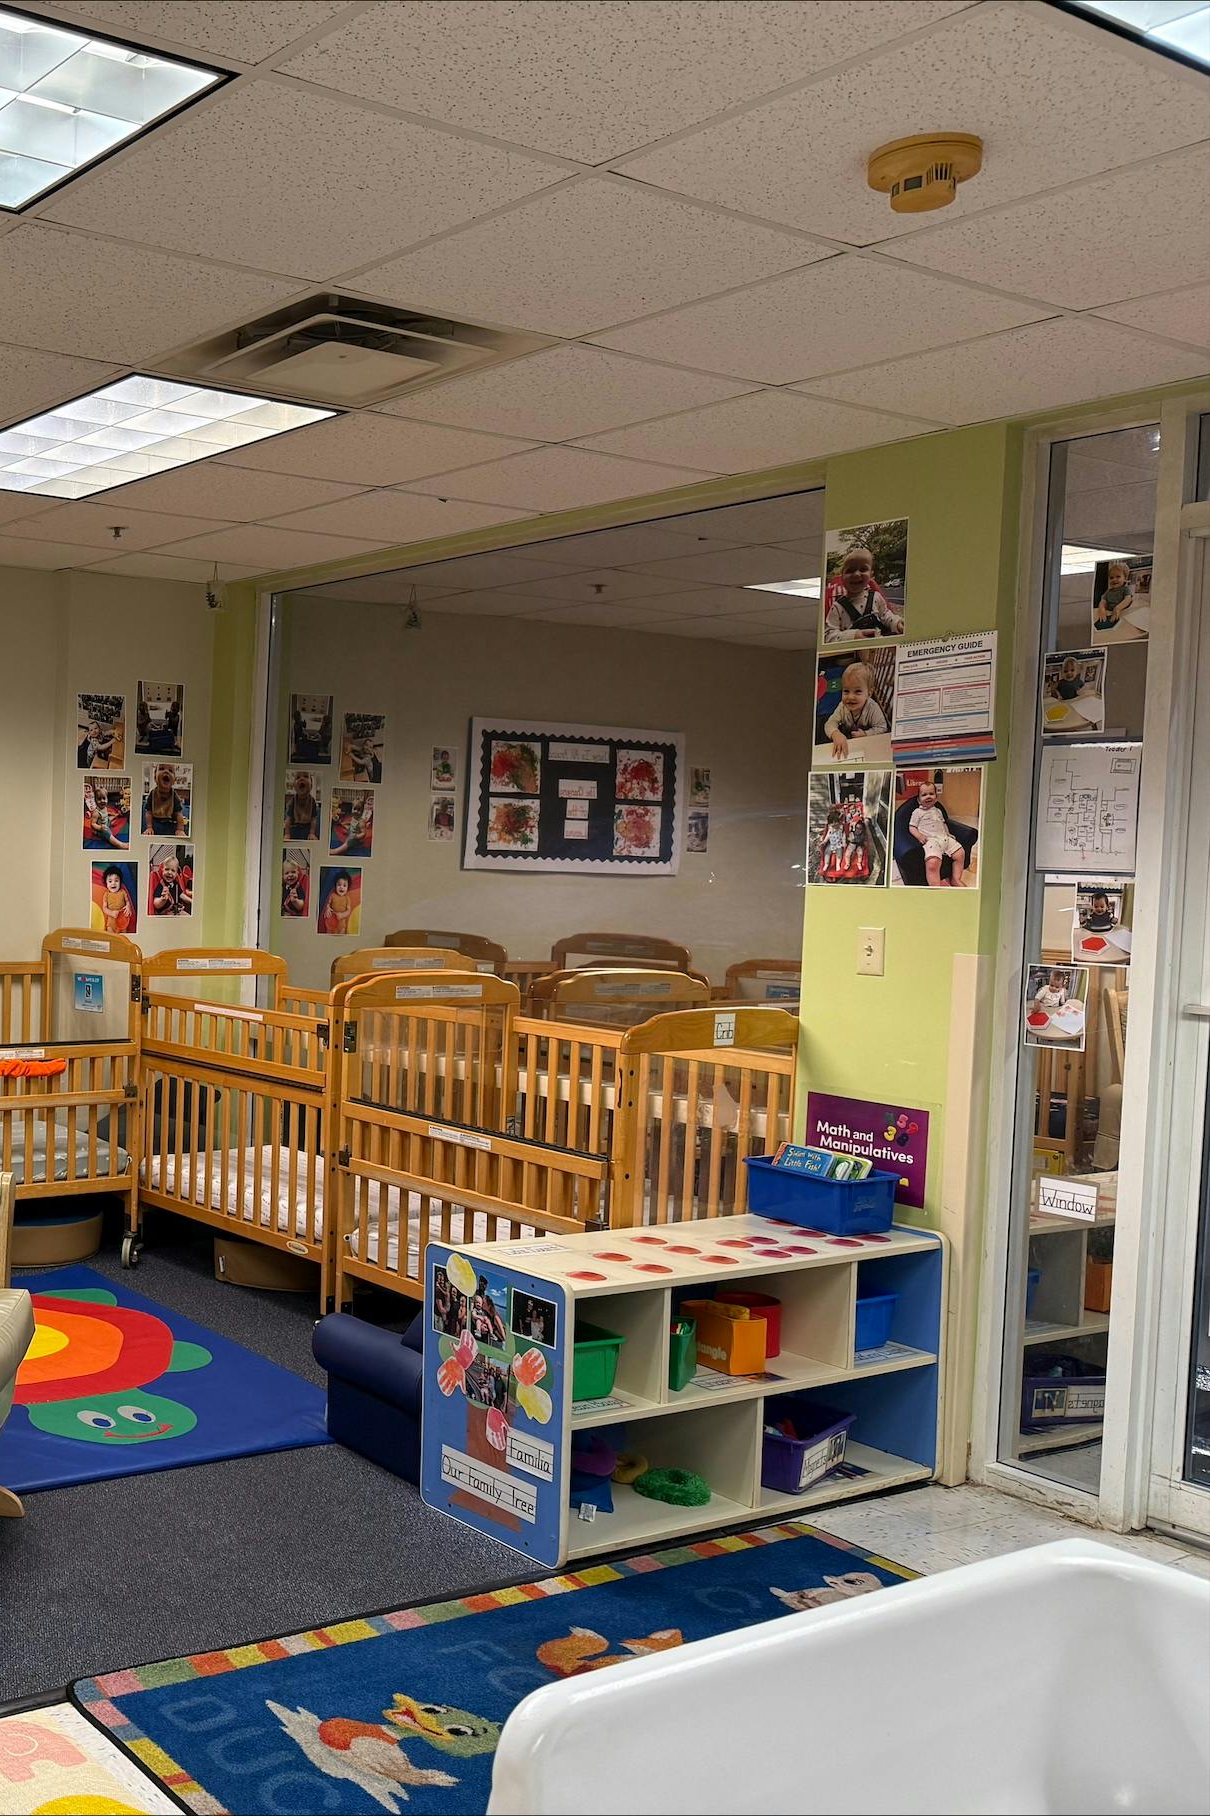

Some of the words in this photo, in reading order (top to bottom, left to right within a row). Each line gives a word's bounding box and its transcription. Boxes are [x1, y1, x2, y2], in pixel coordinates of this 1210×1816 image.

[907, 644, 956, 658] EMERGENCY
[958, 640, 983, 650] GUIDE
[716, 1022, 733, 1039] Crib
[816, 1120, 850, 1138] Math
[853, 1130, 874, 1143] and
[788, 1148, 806, 1158] Swim
[820, 1135, 914, 1165] Manipulatives
[784, 1157, 802, 1167] Little
[804, 1160, 821, 1171] Fish!
[1042, 1189, 1095, 1216] Window
[510, 1436, 552, 1474] Familia
[802, 1450, 827, 1479] Magnets
[442, 1455, 464, 1480] Our
[468, 1466, 502, 1504] Family
[508, 1485, 534, 1516] Tree
